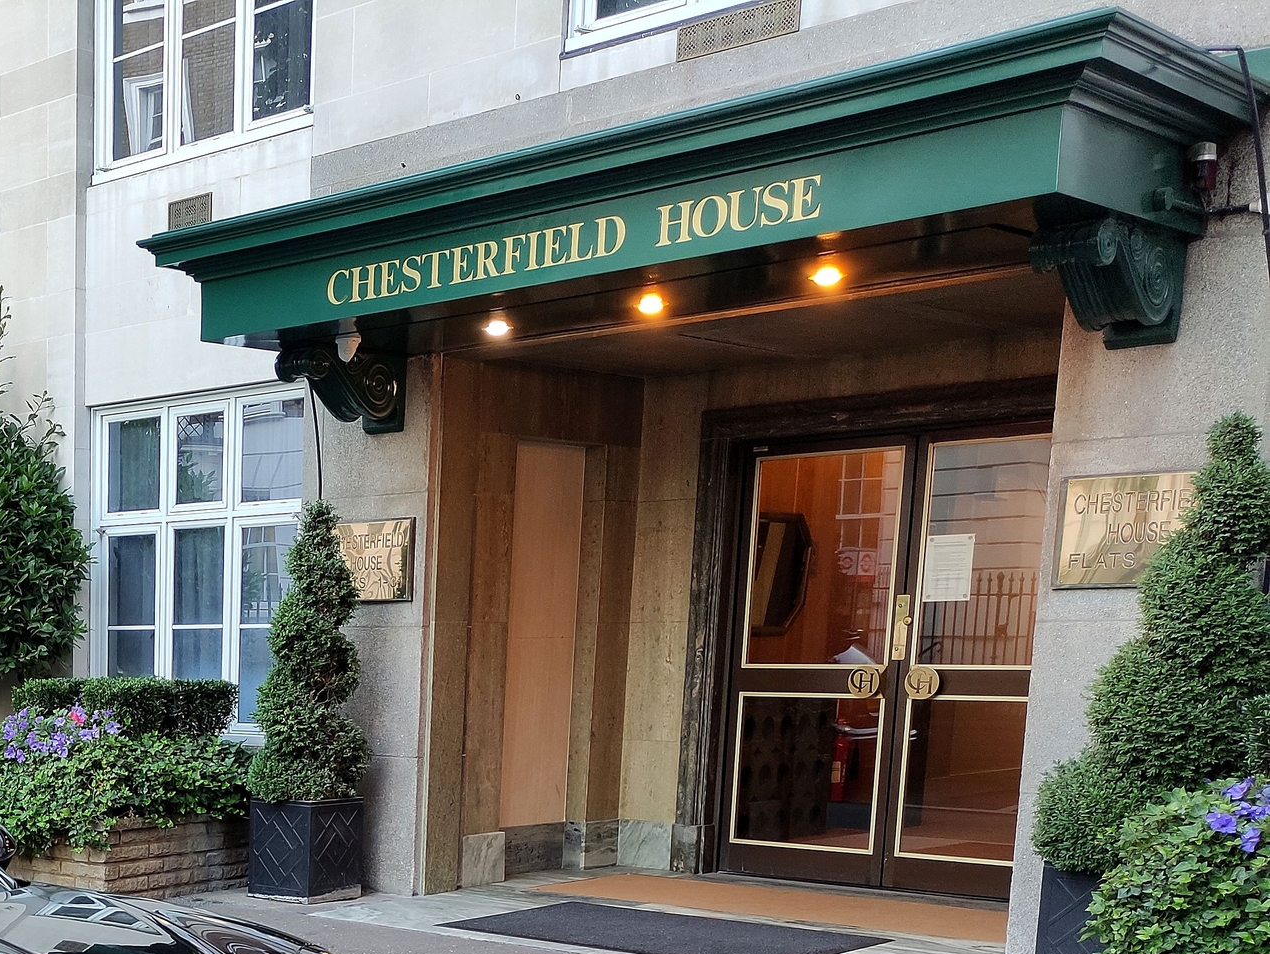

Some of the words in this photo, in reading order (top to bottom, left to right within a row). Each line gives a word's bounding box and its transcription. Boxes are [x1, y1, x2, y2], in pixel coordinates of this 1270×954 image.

[325, 215, 627, 306] CHESTERFIELD
[657, 174, 822, 247] HOUSE
[1074, 488, 1197, 515] CHESTERFIE
[1106, 520, 1172, 545] HOUSE
[350, 555, 383, 572] HOUSE
[1068, 551, 1136, 570] FLATS
